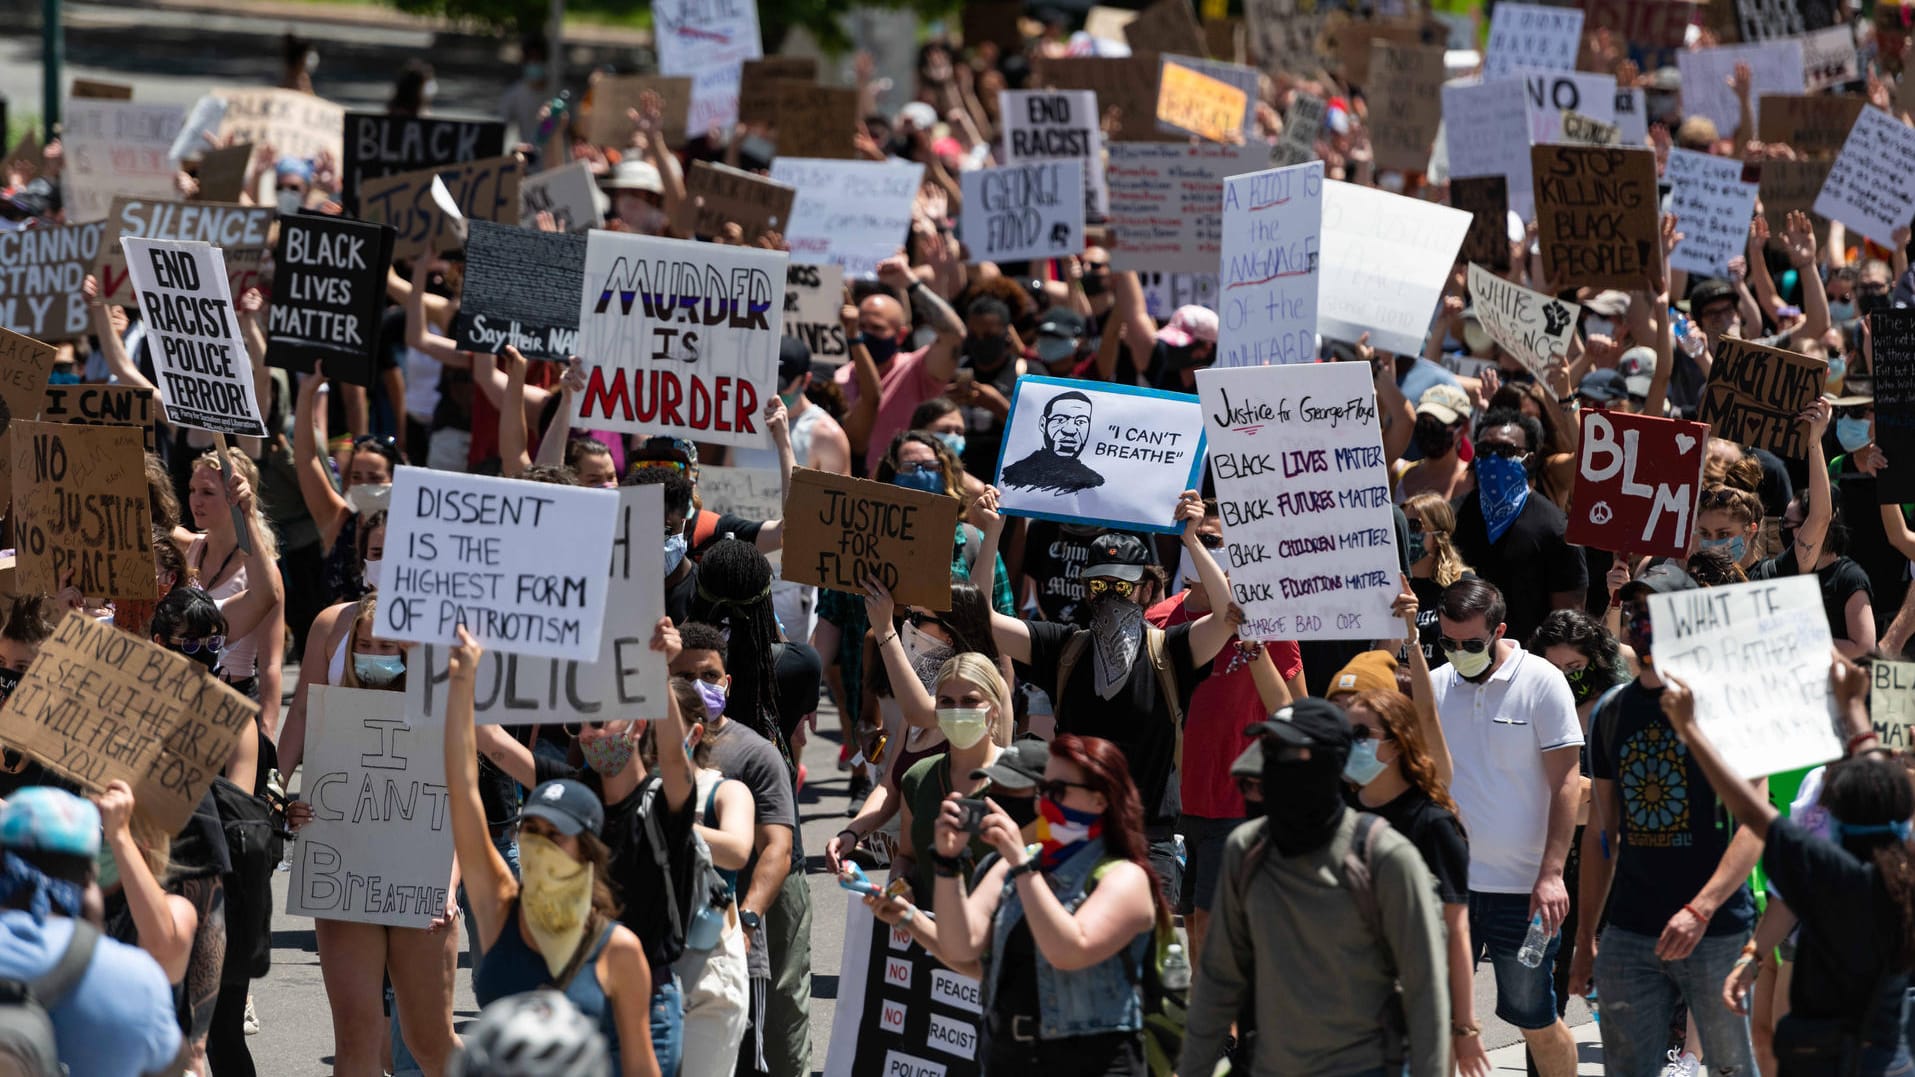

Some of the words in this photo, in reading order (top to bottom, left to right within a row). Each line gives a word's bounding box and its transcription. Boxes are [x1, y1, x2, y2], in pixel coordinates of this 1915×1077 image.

[1027, 95, 1071, 124] END
[357, 117, 481, 163] BLACK
[1011, 128, 1091, 158] RACIST
[1550, 149, 1625, 177] STOP
[980, 163, 1063, 214] GEORGE
[1221, 181, 1241, 212] A
[1302, 162, 1321, 198] IS
[1539, 177, 1641, 209] KILLING
[1, 222, 106, 266] CANNO
[120, 200, 267, 248] SILENCE
[986, 211, 1043, 252] FLOYD
[1555, 212, 1624, 243] BLACK
[148, 247, 200, 291] END
[286, 226, 367, 271] BLACK
[1551, 241, 1650, 277] PEOPLE!
[289, 272, 353, 306] LIVES
[594, 256, 773, 331] MURDER
[1265, 289, 1306, 323] the
[1474, 271, 1537, 325] WHITE
[0, 294, 56, 336] LY
[142, 290, 232, 339] RACIST
[268, 304, 363, 345] MATTER
[469, 314, 506, 354] Say
[160, 335, 236, 379] POLICE
[651, 327, 699, 364] IS
[1708, 340, 1771, 402] BLACK
[45, 389, 69, 415] I
[162, 371, 252, 418] TERROR!
[579, 365, 758, 434] MURDER
[1213, 387, 1275, 428] Justice
[1276, 397, 1291, 424] for
[1300, 395, 1344, 429] George
[1343, 392, 1376, 426] Floyd
[32, 433, 68, 484] NO
[1094, 441, 1184, 465] BREATHE"
[1125, 427, 1183, 447] CAN'T
[1213, 451, 1276, 480] BLACK
[1281, 449, 1329, 479] LIVES
[1334, 445, 1386, 473] MATTER
[47, 486, 150, 553] JUSTICE
[416, 486, 555, 527] DISSENT
[819, 488, 919, 542] JUSTICE
[1220, 498, 1275, 527] BLACK
[1276, 490, 1337, 518] FUTURES
[1338, 486, 1391, 509] MATTER
[14, 514, 46, 557] NO
[408, 532, 438, 561] IS
[449, 534, 502, 566] THE
[837, 529, 881, 560] FOR
[1228, 542, 1272, 569] BLACK
[1278, 534, 1336, 559] CHILDREN
[1339, 527, 1392, 550] MATTER
[51, 544, 119, 596] PEACE
[393, 565, 505, 600] HIGHEST
[516, 574, 587, 608] FORM
[815, 551, 899, 593] FLOYD
[1233, 582, 1275, 606] BLACK
[1279, 573, 1344, 601] EDUCATIONS
[1344, 570, 1391, 591] MATTER
[388, 597, 427, 632] OF
[437, 600, 581, 646] PATRIOTISM
[1240, 615, 1288, 638] CHARGE
[1295, 614, 1323, 634] BAD
[1335, 612, 1363, 631] COPS
[1665, 591, 1732, 640] WHAT
[90, 622, 145, 671] NOT
[212, 693, 253, 736] BUT
[422, 636, 647, 718] POLICE
[28, 652, 54, 679] I
[46, 658, 101, 699] SEE
[120, 685, 141, 719] I
[137, 698, 208, 761] HEAR
[205, 737, 231, 768] U
[35, 689, 91, 742] WILL
[87, 717, 156, 768] FIGHT
[146, 748, 202, 801] FOR
[55, 740, 107, 783] YOU
[360, 718, 411, 771] I
[309, 771, 450, 832] CANT
[892, 930, 910, 945] NO
[888, 962, 909, 982] NO
[883, 1006, 904, 1026] NO
[929, 1022, 977, 1050] RACIST
